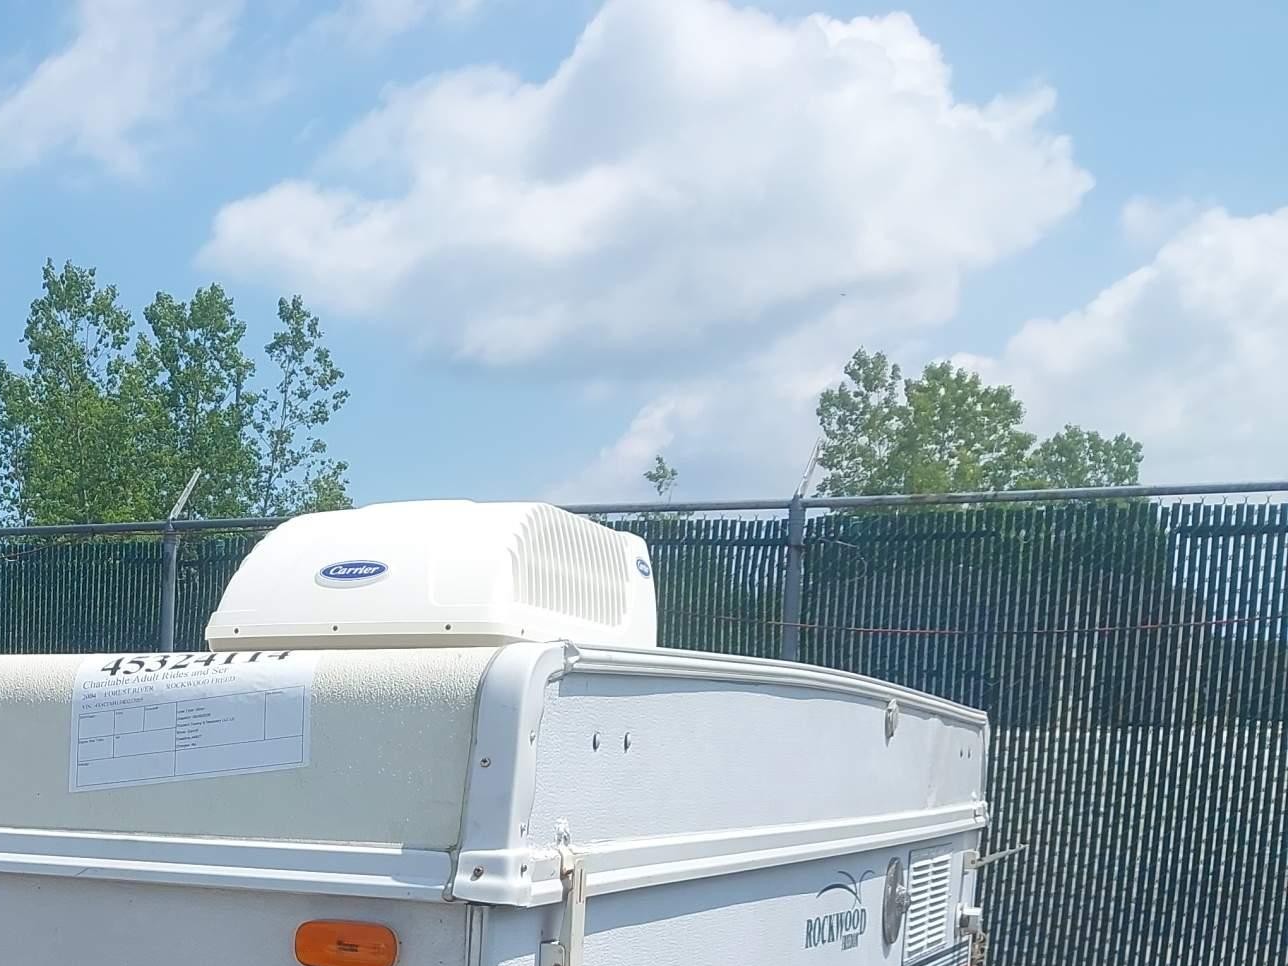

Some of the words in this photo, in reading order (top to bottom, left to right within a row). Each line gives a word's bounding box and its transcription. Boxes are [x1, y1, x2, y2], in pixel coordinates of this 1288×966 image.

[329, 564, 380, 577] Carrier
[100, 651, 291, 676] 45324114
[82, 676, 130, 690] Charitable
[132, 673, 159, 684] Adult
[161, 670, 189, 681] Rides
[191, 668, 210, 677] and
[104, 687, 131, 698] FOREST
[132, 685, 154, 695] RIVER
[166, 679, 210, 690] ROCKWOOD
[805, 908, 867, 949] ROCKWOOD
